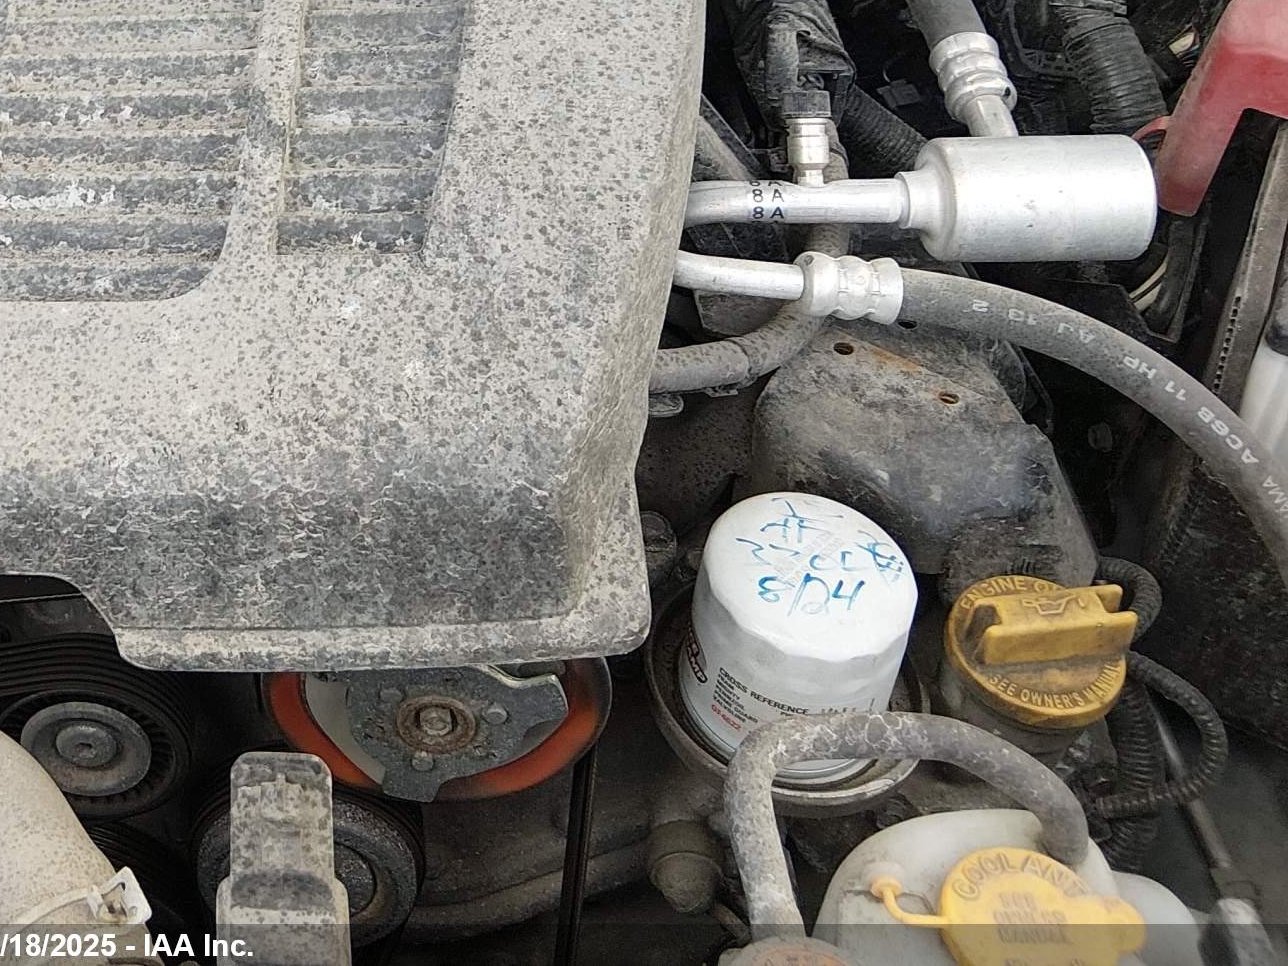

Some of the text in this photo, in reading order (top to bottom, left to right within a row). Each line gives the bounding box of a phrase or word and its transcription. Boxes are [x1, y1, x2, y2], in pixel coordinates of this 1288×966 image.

[752, 188, 784, 202] 8 A
[753, 206, 784, 219] 8 A
[1123, 356, 1157, 379] HP
[960, 577, 1028, 610] ENGINE
[720, 667, 809, 716] CROSS REFERENCE
[989, 663, 1121, 709] SEE OWNER'S MANUAL
[952, 851, 1090, 900] COOLANT
